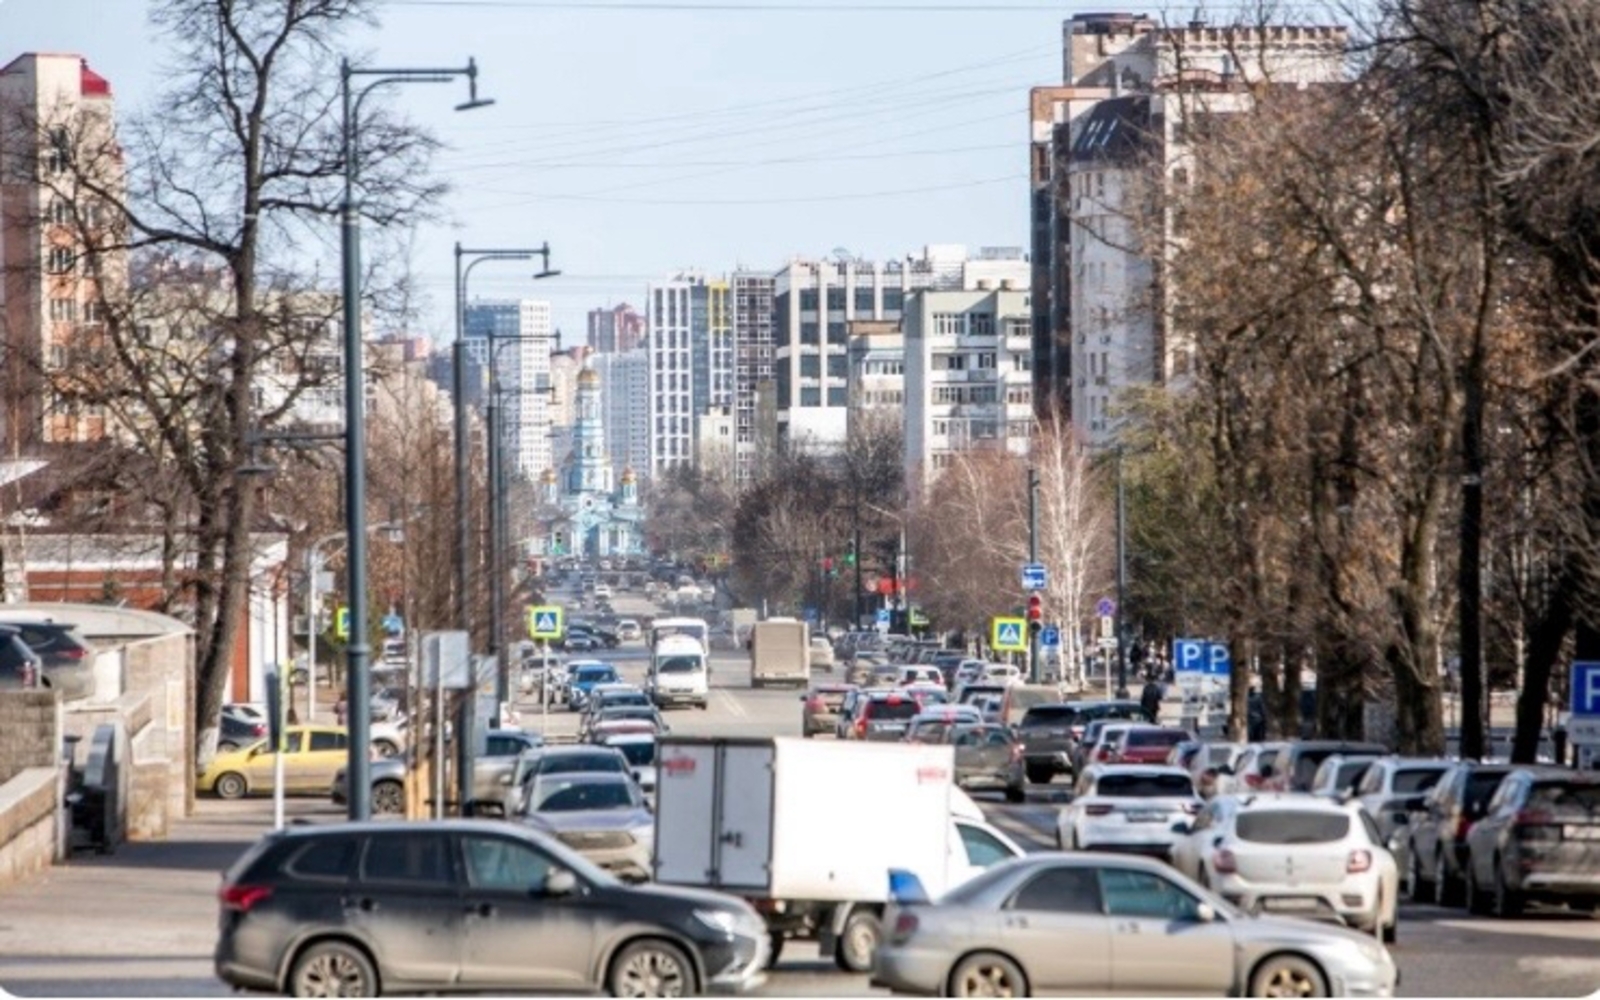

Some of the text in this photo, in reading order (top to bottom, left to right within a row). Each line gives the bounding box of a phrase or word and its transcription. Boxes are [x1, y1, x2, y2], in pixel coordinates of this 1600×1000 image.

[1045, 629, 1057, 644] P
[1182, 643, 1200, 668] P
[1210, 645, 1229, 671] P
